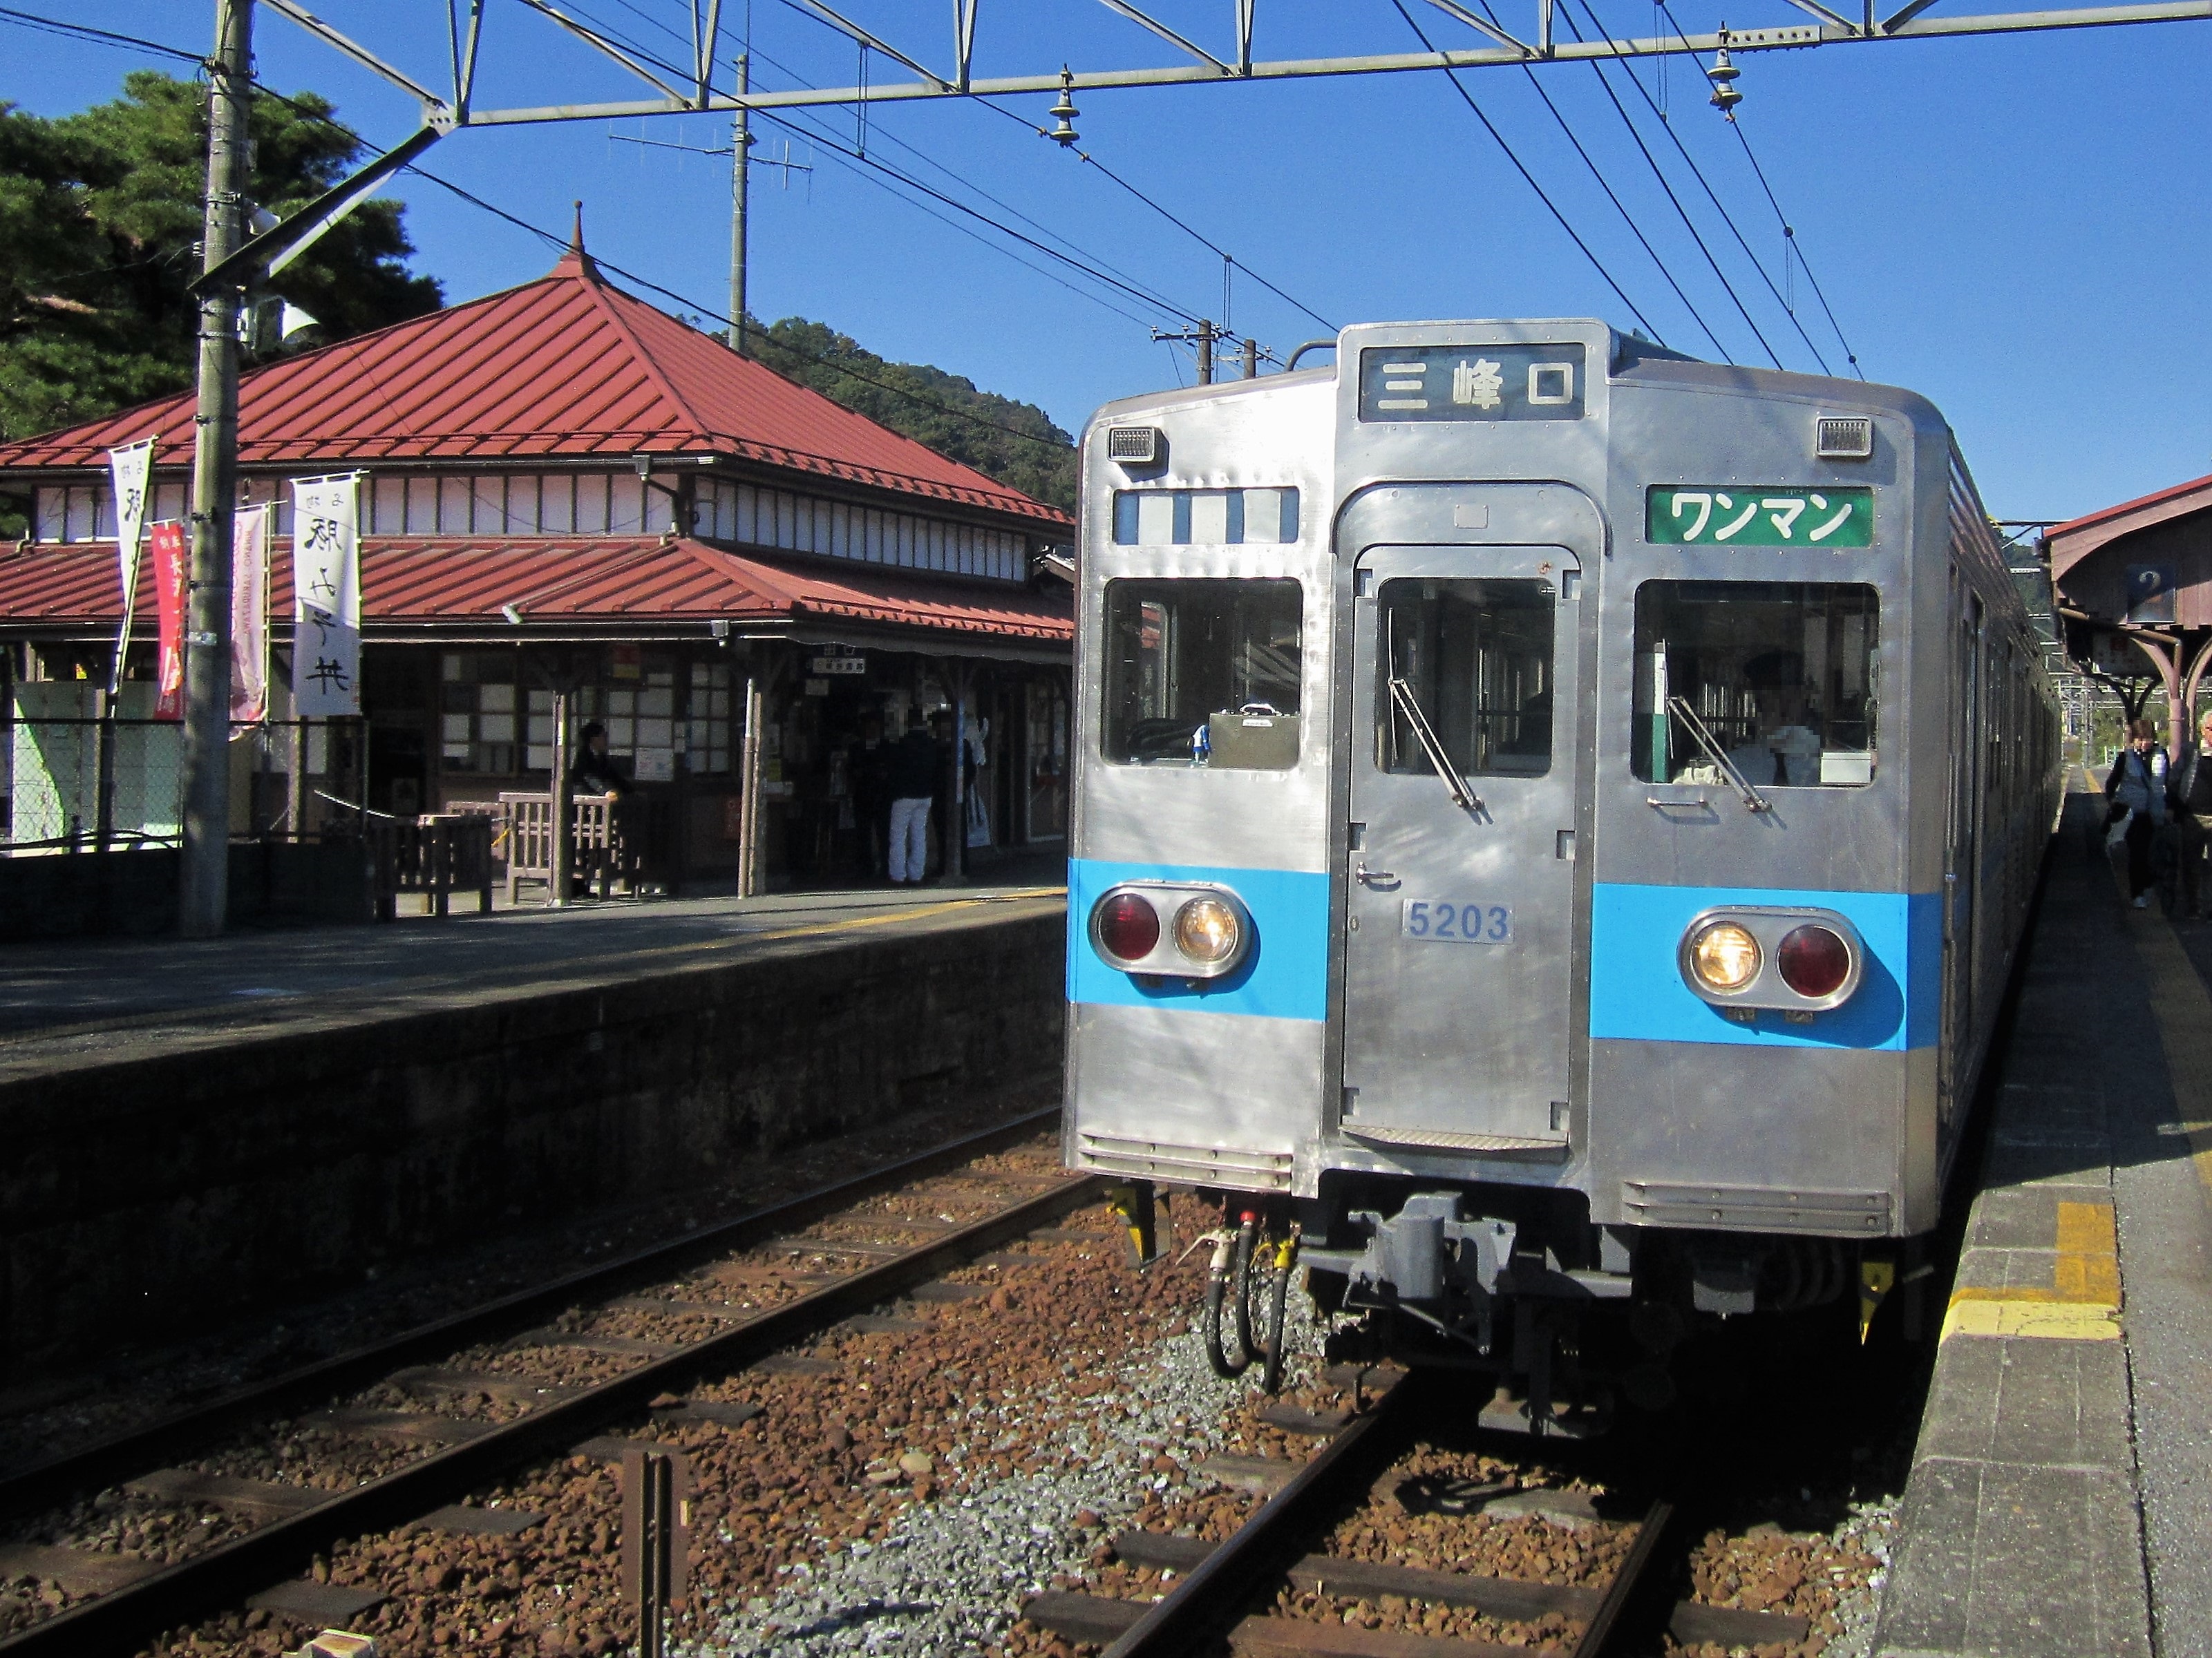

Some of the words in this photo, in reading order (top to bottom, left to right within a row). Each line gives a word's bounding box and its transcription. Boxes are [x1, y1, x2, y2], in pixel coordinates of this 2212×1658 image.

[1377, 358, 1574, 410] 三峰口
[1672, 493, 1853, 542] ワンマン
[2138, 570, 2164, 604] 2
[1410, 902, 1509, 940] 5203
